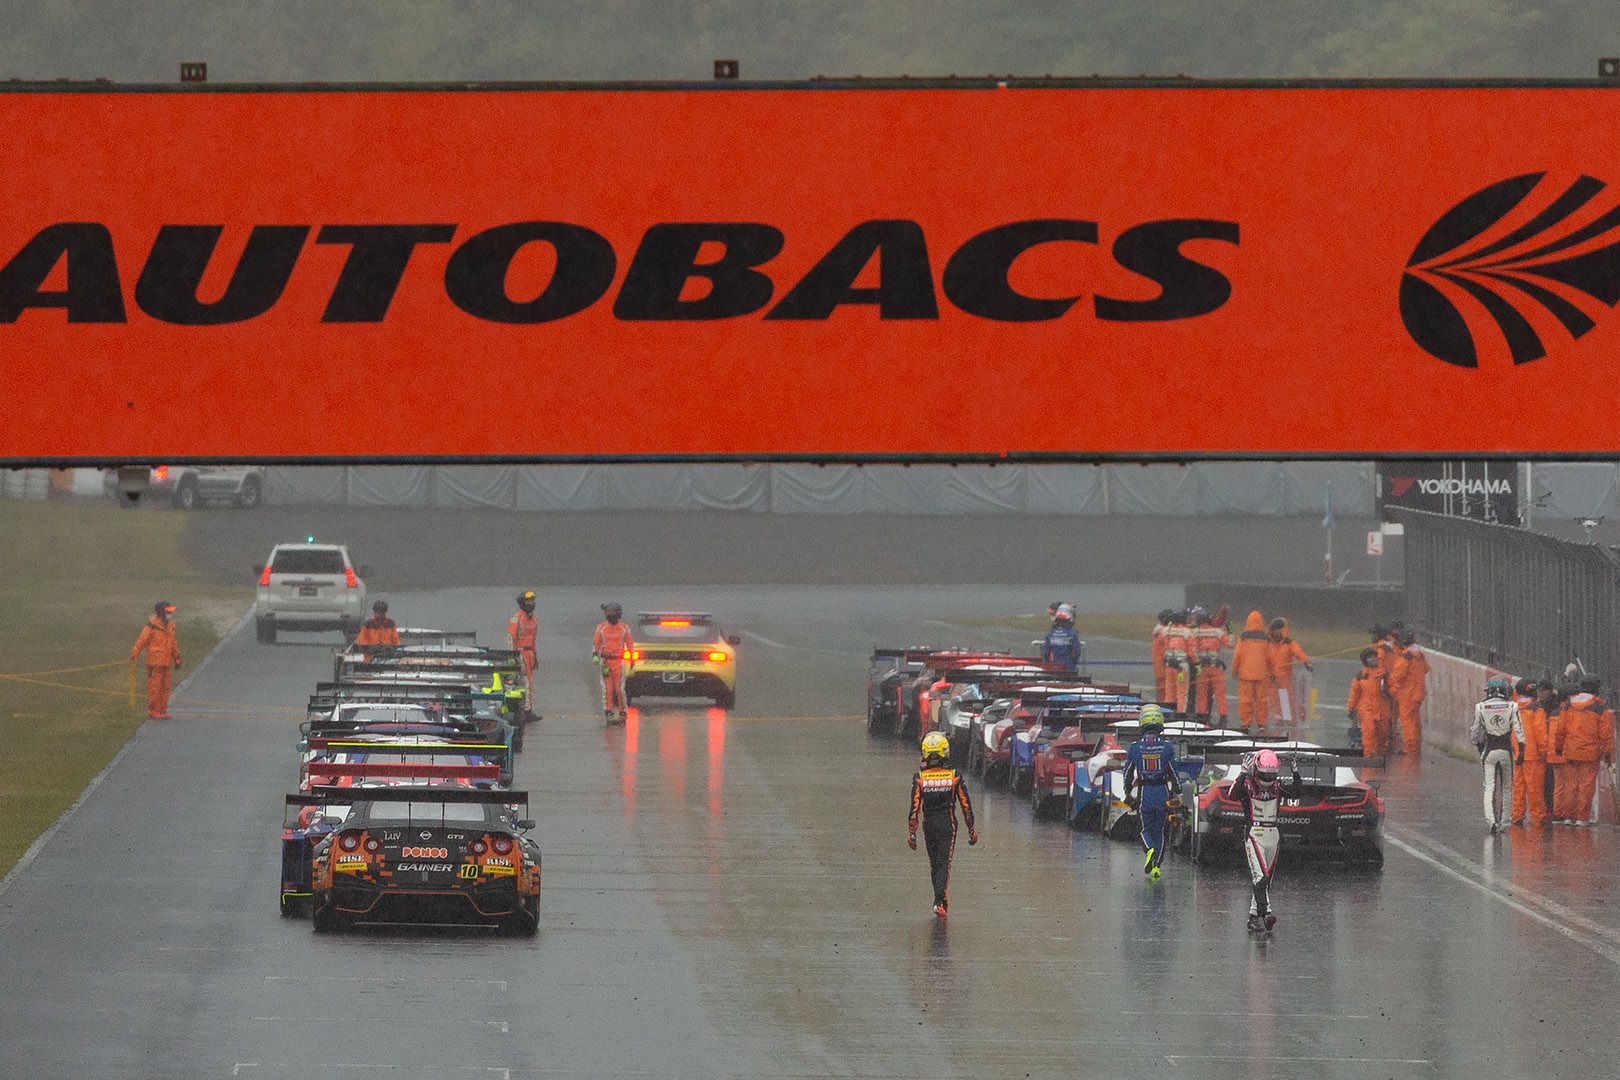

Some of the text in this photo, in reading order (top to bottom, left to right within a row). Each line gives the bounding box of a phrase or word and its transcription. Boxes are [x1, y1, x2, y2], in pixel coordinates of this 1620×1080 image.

[0, 219, 1240, 325] AUTOBACS
[1417, 479, 1512, 494] YOKOHAMA
[402, 847, 448, 858] PONOS
[397, 863, 453, 872] GAINER
[461, 865, 477, 878] 10
